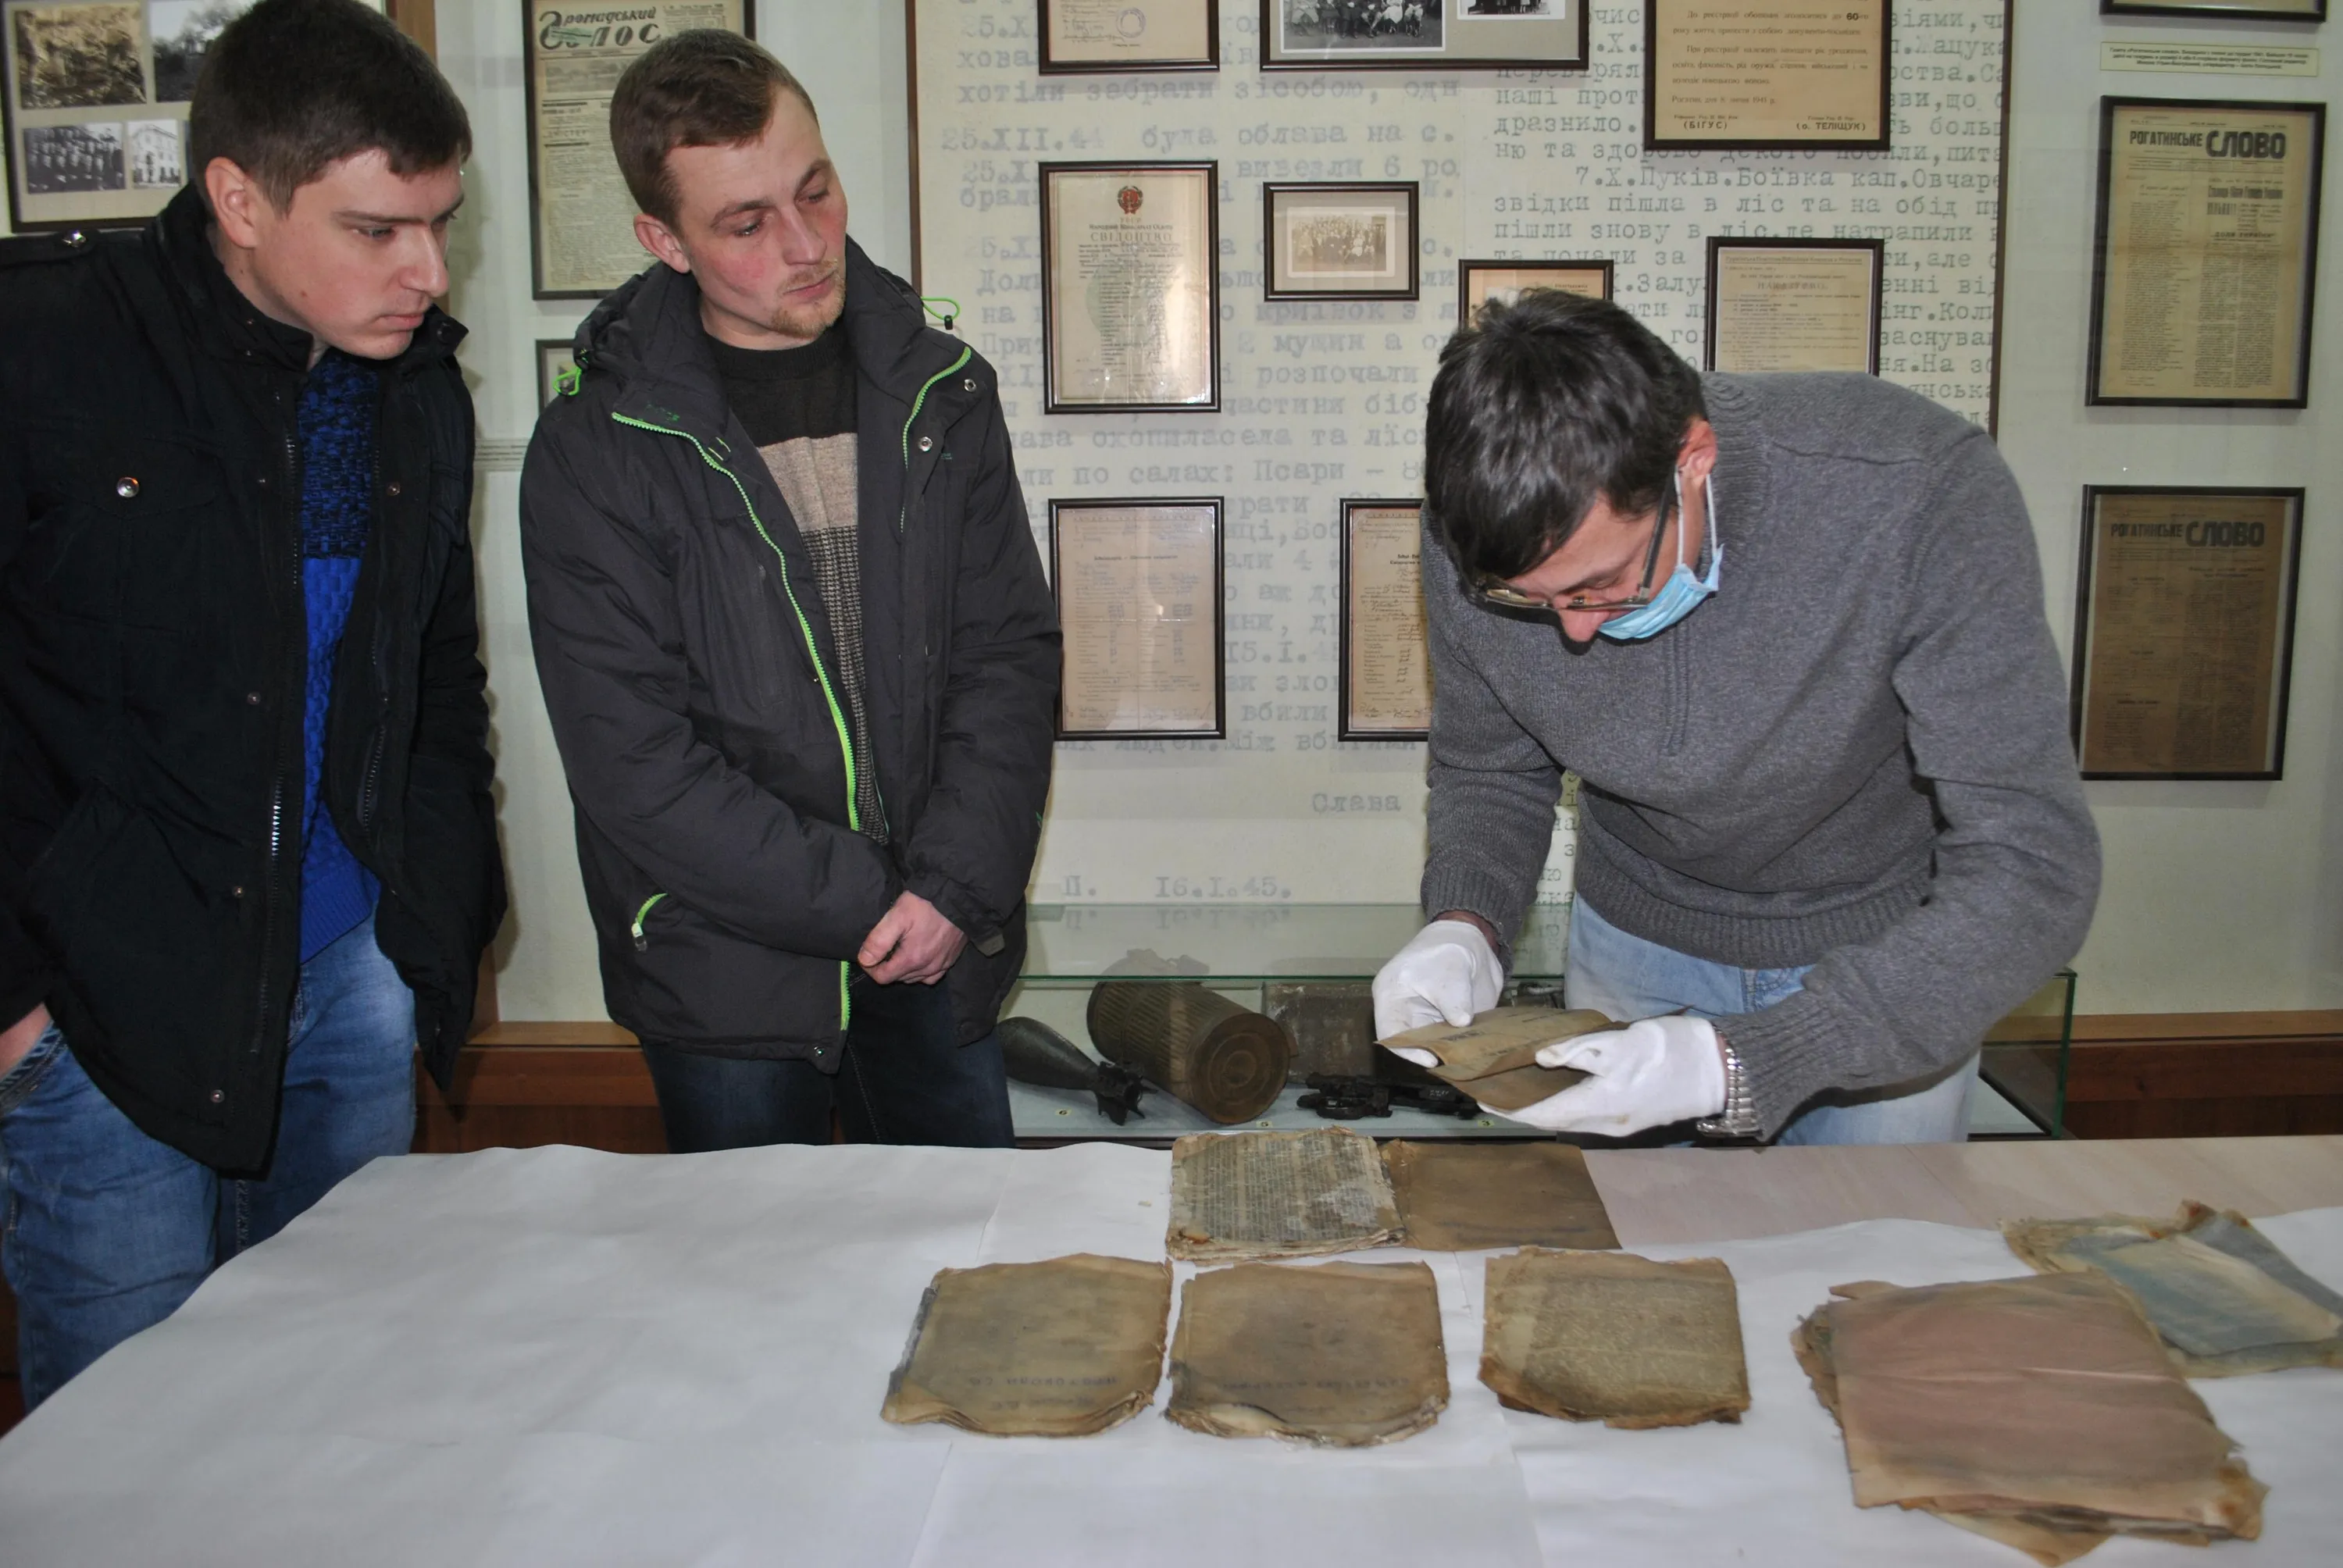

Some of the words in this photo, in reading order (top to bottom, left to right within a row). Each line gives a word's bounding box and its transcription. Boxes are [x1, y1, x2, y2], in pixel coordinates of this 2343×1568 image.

[1577, 89, 1644, 109] прот
[1367, 123, 1404, 143] на
[1544, 142, 1577, 159] та
[2129, 130, 2203, 148] РОГАТИНСЬКЕ
[2205, 129, 2287, 160] СЛОВО
[1494, 192, 1591, 216] звідки
[1607, 192, 1686, 213] пішла
[1703, 197, 1719, 212] в
[1735, 194, 1785, 214] ліс
[1801, 197, 1838, 213] та
[1850, 197, 1881, 213] на
[1494, 219, 1573, 240] пішли
[1590, 223, 1672, 244] знову
[1687, 223, 1702, 240] в
[1656, 250, 1686, 266] за
[1312, 429, 1348, 447] та
[1073, 466, 1110, 486] по
[2184, 521, 2266, 547] СЛОВО
[1311, 792, 1402, 814] Слава
